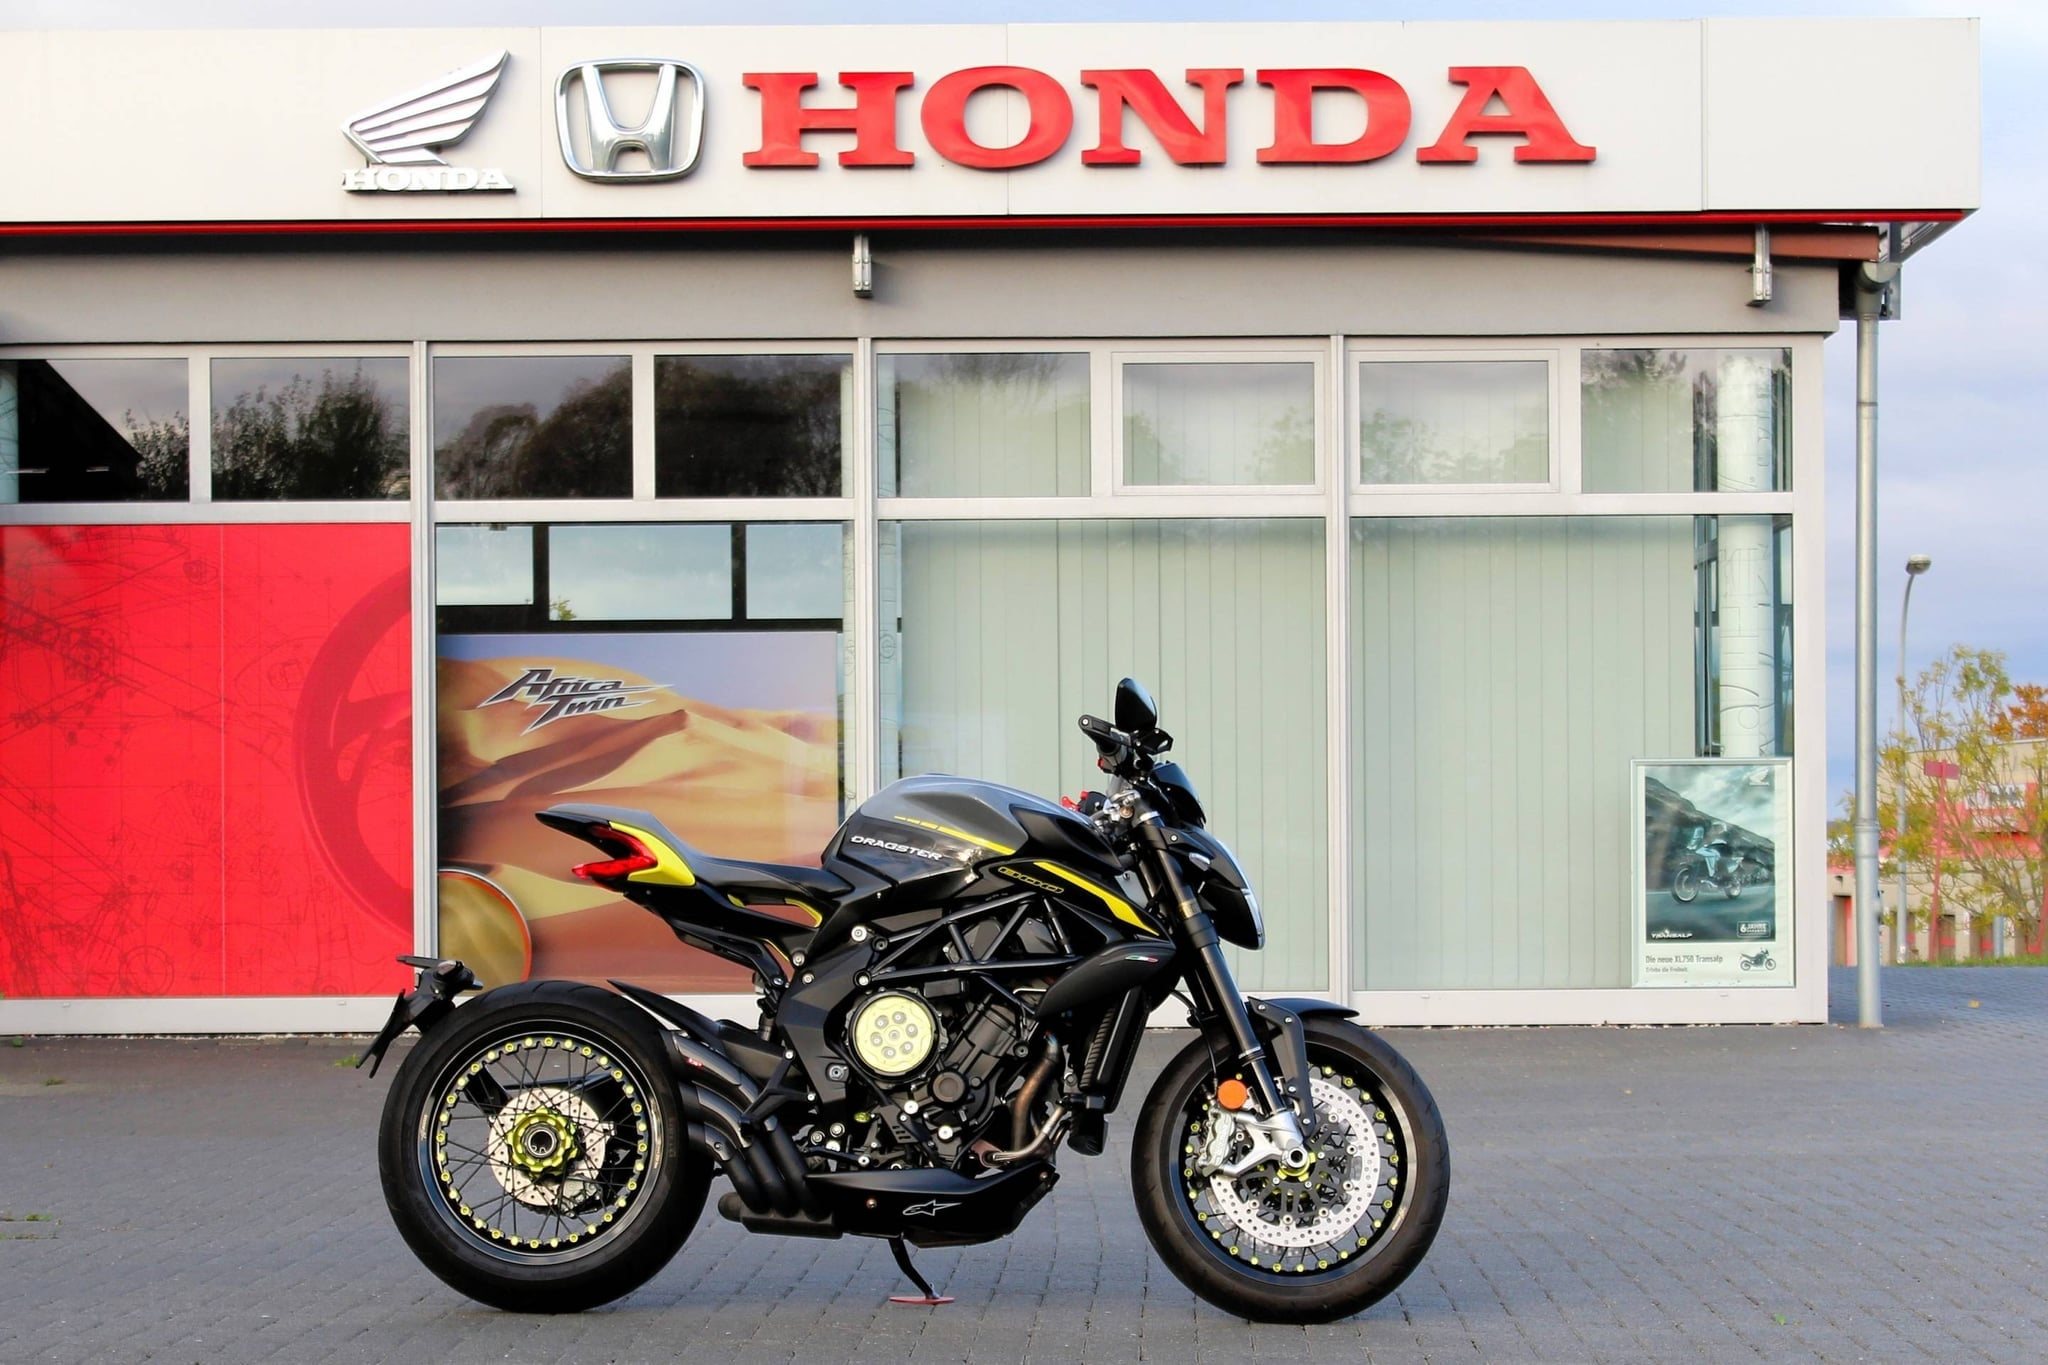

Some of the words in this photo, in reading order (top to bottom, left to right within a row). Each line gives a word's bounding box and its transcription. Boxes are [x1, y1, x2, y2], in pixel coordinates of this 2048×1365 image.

[742, 65, 1597, 170] HONDA
[342, 167, 516, 192] HONDA
[478, 665, 660, 708] Africa
[521, 692, 645, 736] Twin
[850, 835, 943, 861] DRAGSTER
